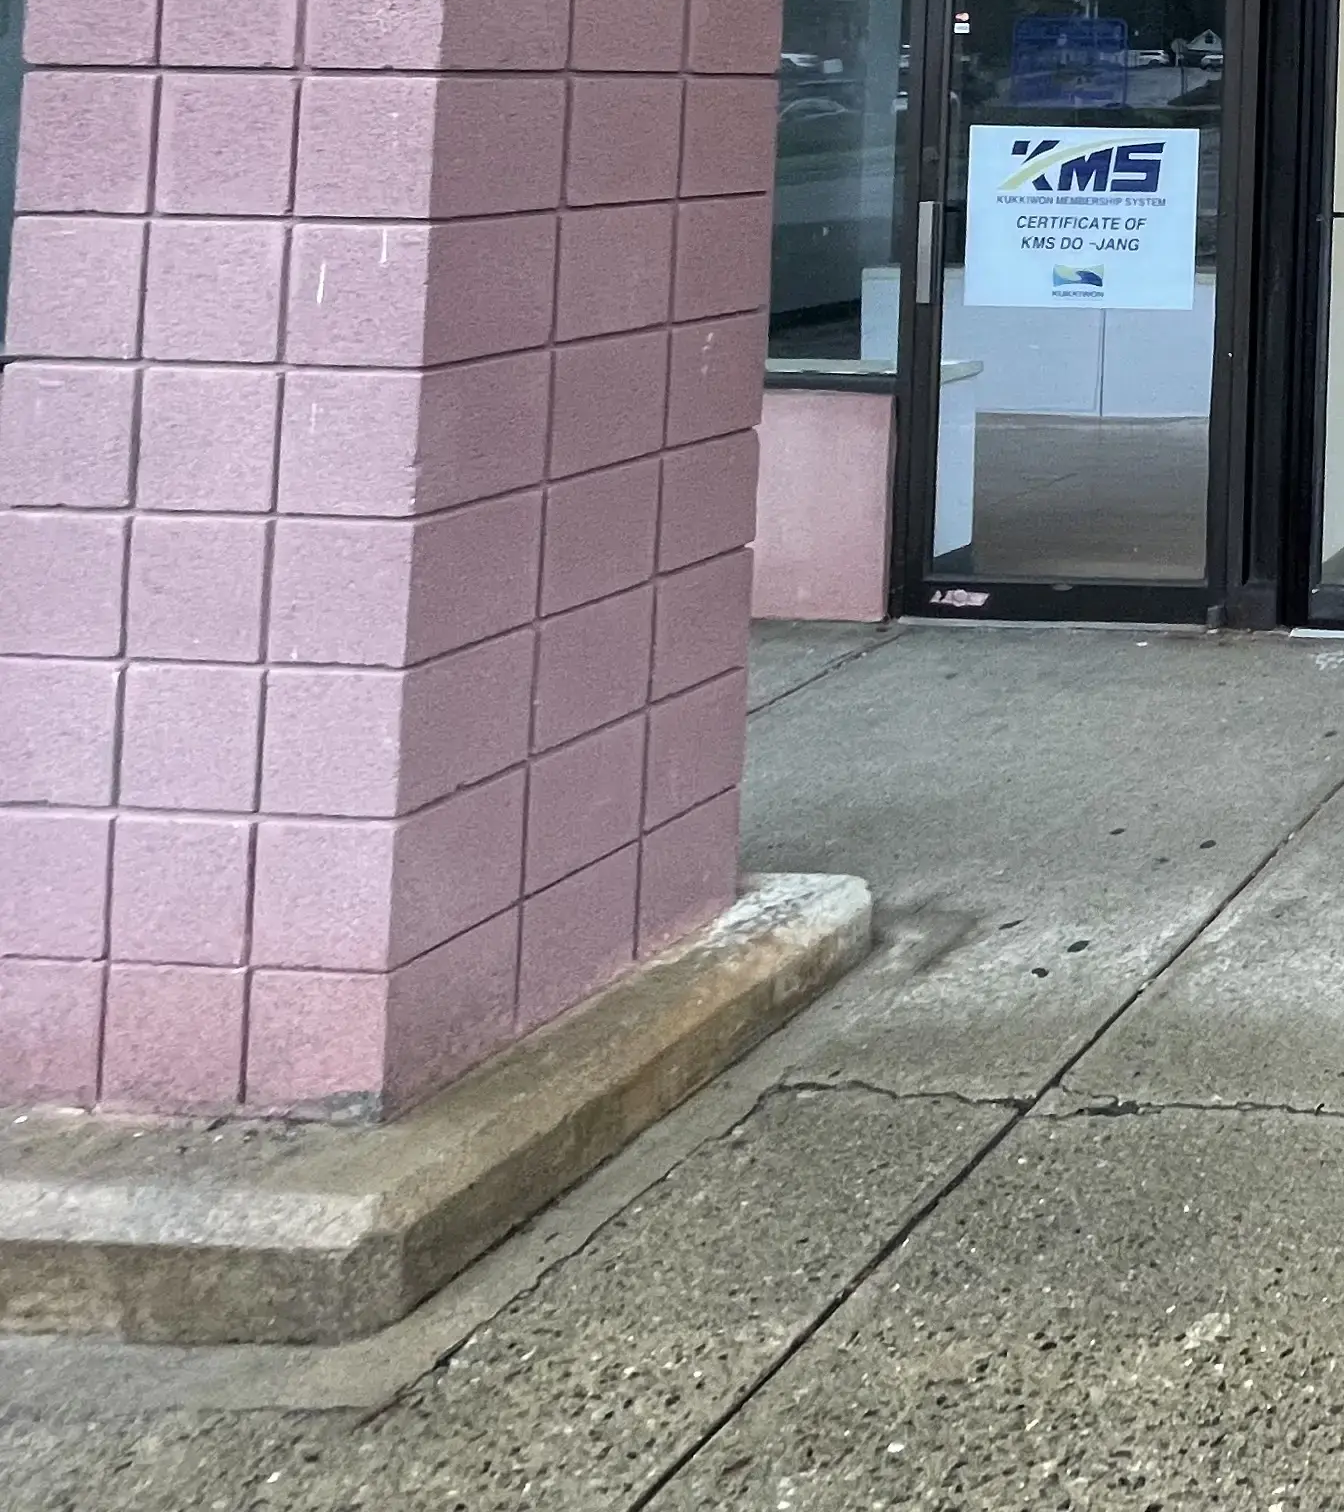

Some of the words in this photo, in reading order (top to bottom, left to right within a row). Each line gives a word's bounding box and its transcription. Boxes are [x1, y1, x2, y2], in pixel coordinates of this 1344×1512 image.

[1009, 139, 1166, 192] KMS
[1056, 196, 1123, 206] MEMBERSHIP
[1125, 197, 1167, 207] SYSTEM
[1016, 215, 1121, 230] CERTIFICATE
[1124, 217, 1147, 231] OF
[1020, 236, 1056, 250] KMS
[1060, 237, 1083, 250] DO
